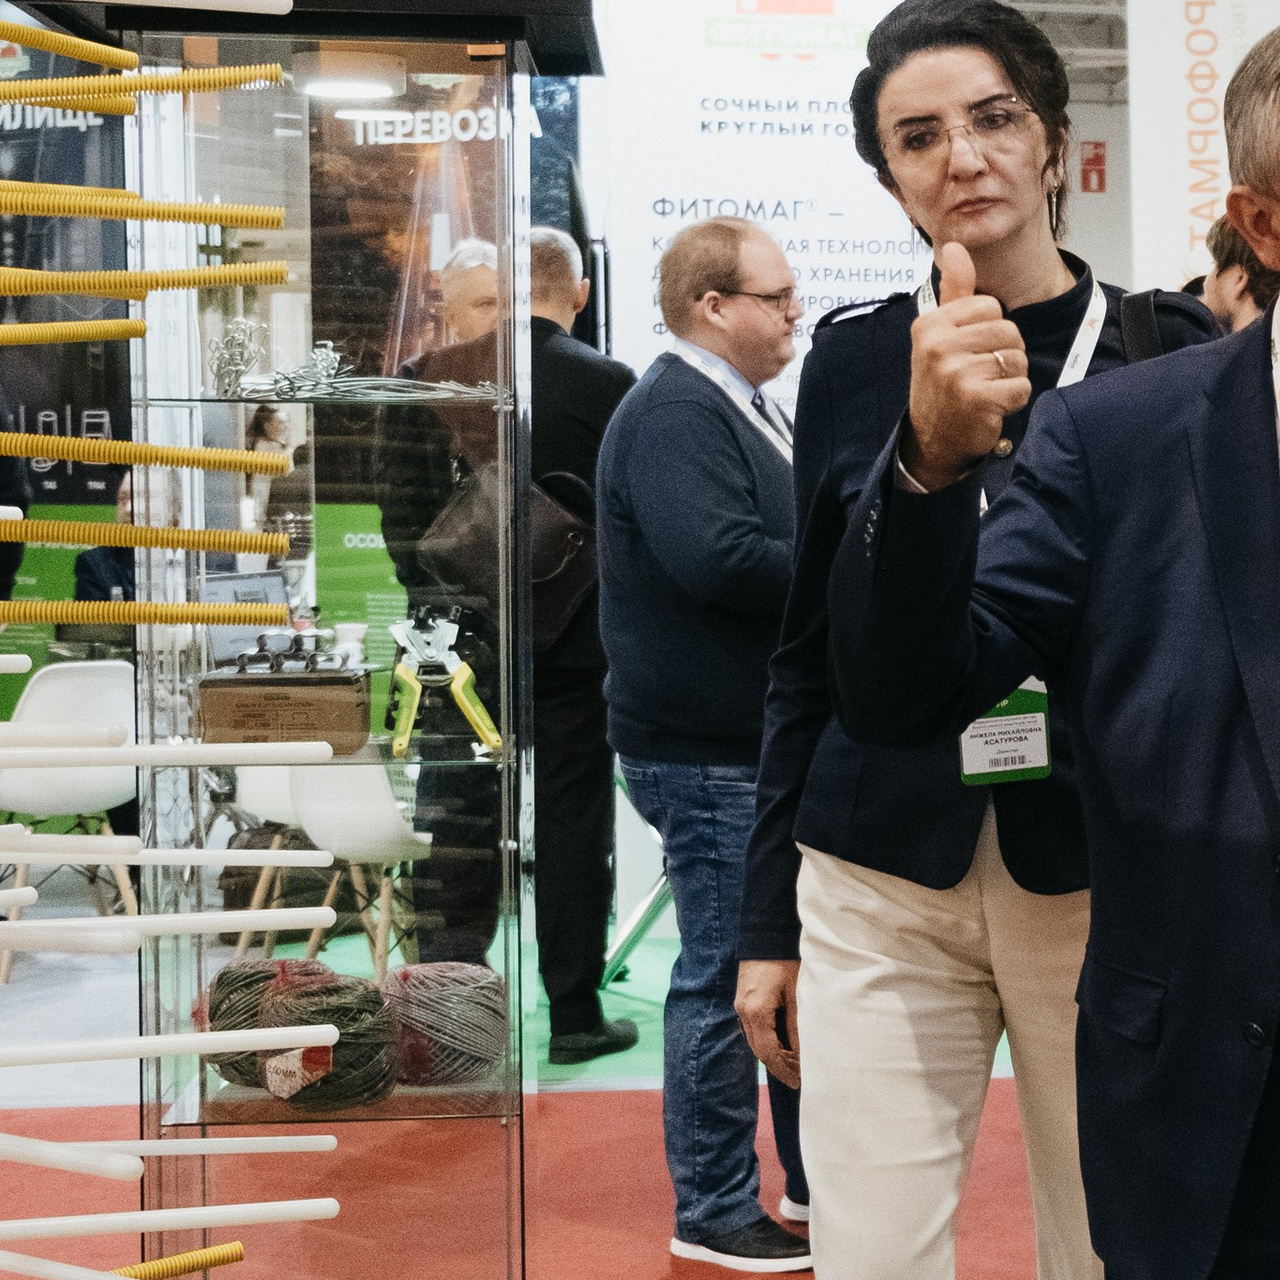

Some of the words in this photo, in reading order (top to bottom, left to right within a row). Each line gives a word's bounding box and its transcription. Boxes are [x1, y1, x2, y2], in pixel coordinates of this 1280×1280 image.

[700, 97, 799, 114] СОЧНЫЙ
[807, 100, 854, 115] ПЛО
[700, 120, 814, 137] КРУГЛЫЙ
[823, 123, 856, 138] ГО
[810, 267, 915, 283] ХРАНЕНИЯ
[984, 735, 1029, 746] АСАТУРОВА
